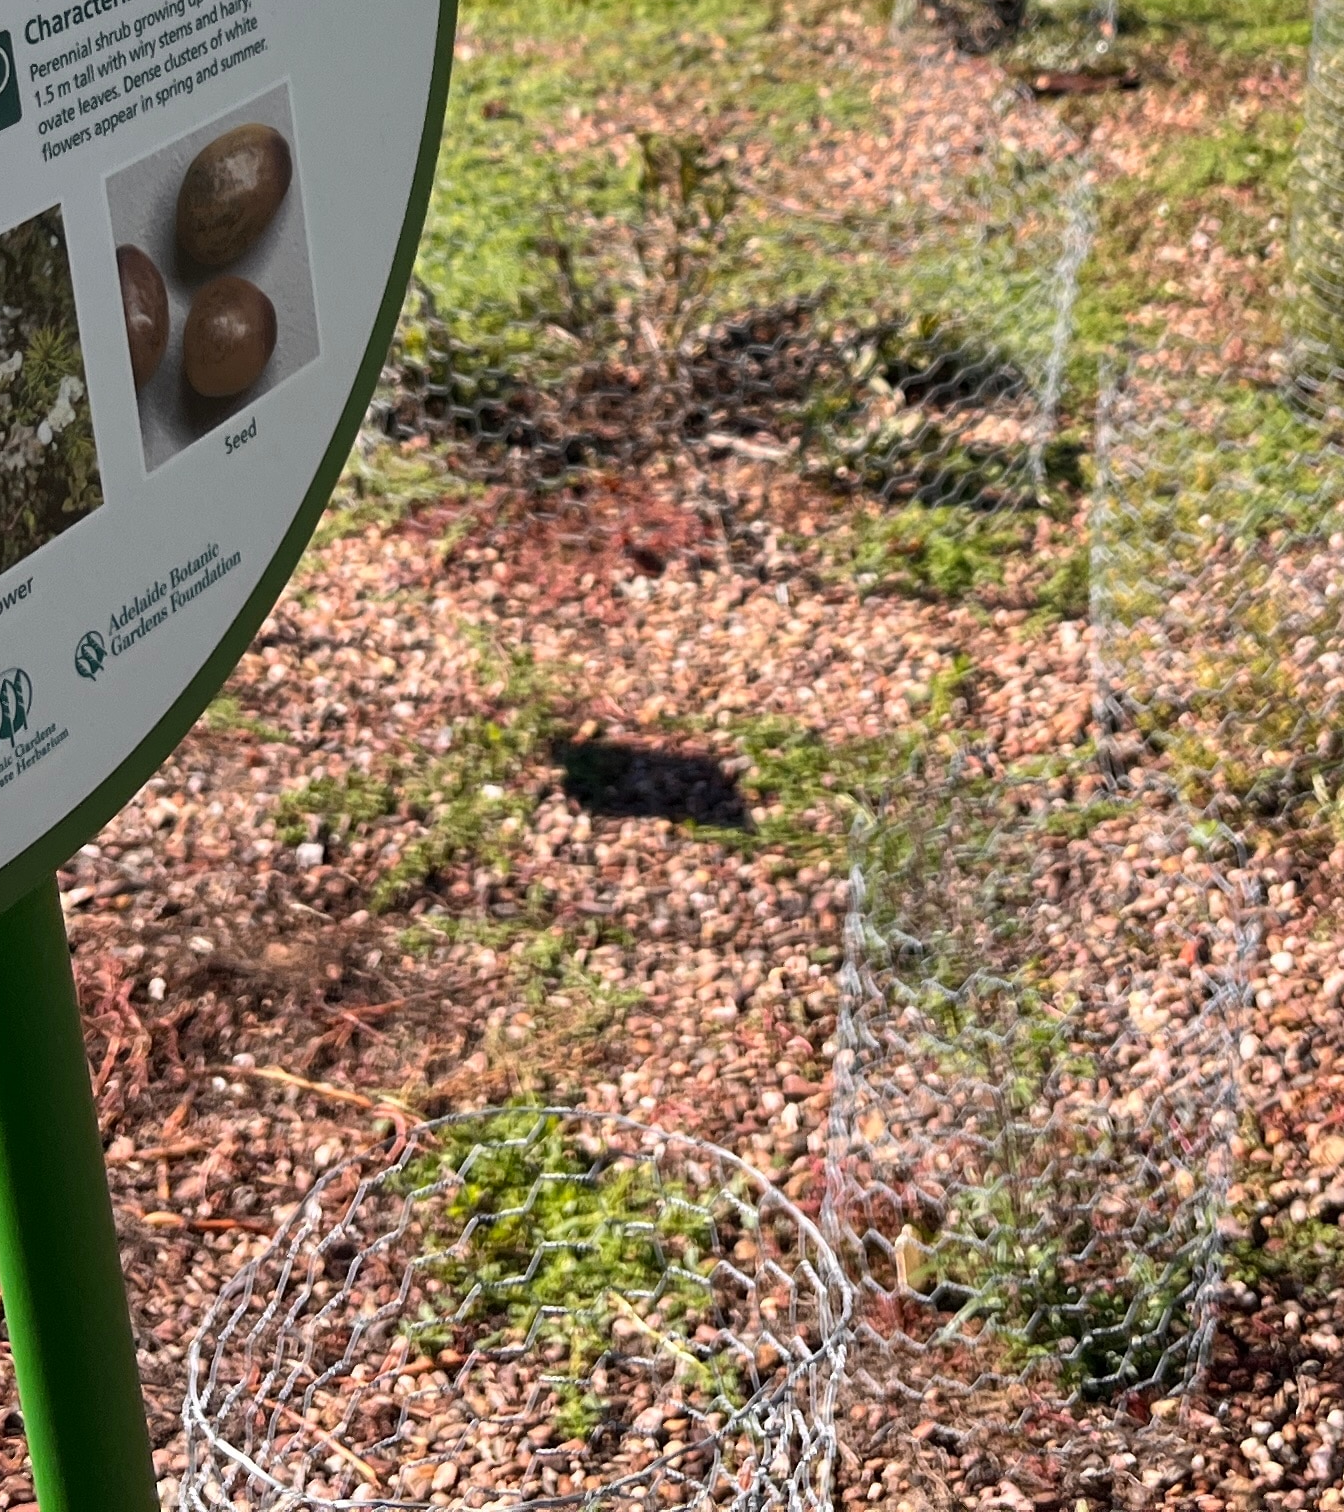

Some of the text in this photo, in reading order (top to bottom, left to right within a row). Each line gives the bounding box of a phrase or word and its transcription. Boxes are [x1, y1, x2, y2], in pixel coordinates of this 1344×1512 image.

[29, 36, 93, 83] Perennial
[94, 20, 132, 52] shrub
[34, 83, 55, 108] 1.5
[57, 80, 71, 98] m
[72, 64, 95, 90] tall
[96, 50, 127, 78] with
[128, 39, 157, 63] wiry
[158, 21, 194, 49] stems
[195, 4, 219, 32] and
[38, 16, 258, 136] ovate leaves. Dense clusters of white
[41, 38, 268, 163] flowers appear in spring and summer.
[224, 416, 257, 455] Seed
[108, 543, 219, 636] Adelaide Botanic
[110, 551, 242, 657] Gardens Foundation
[14, 723, 57, 759] Gardens
